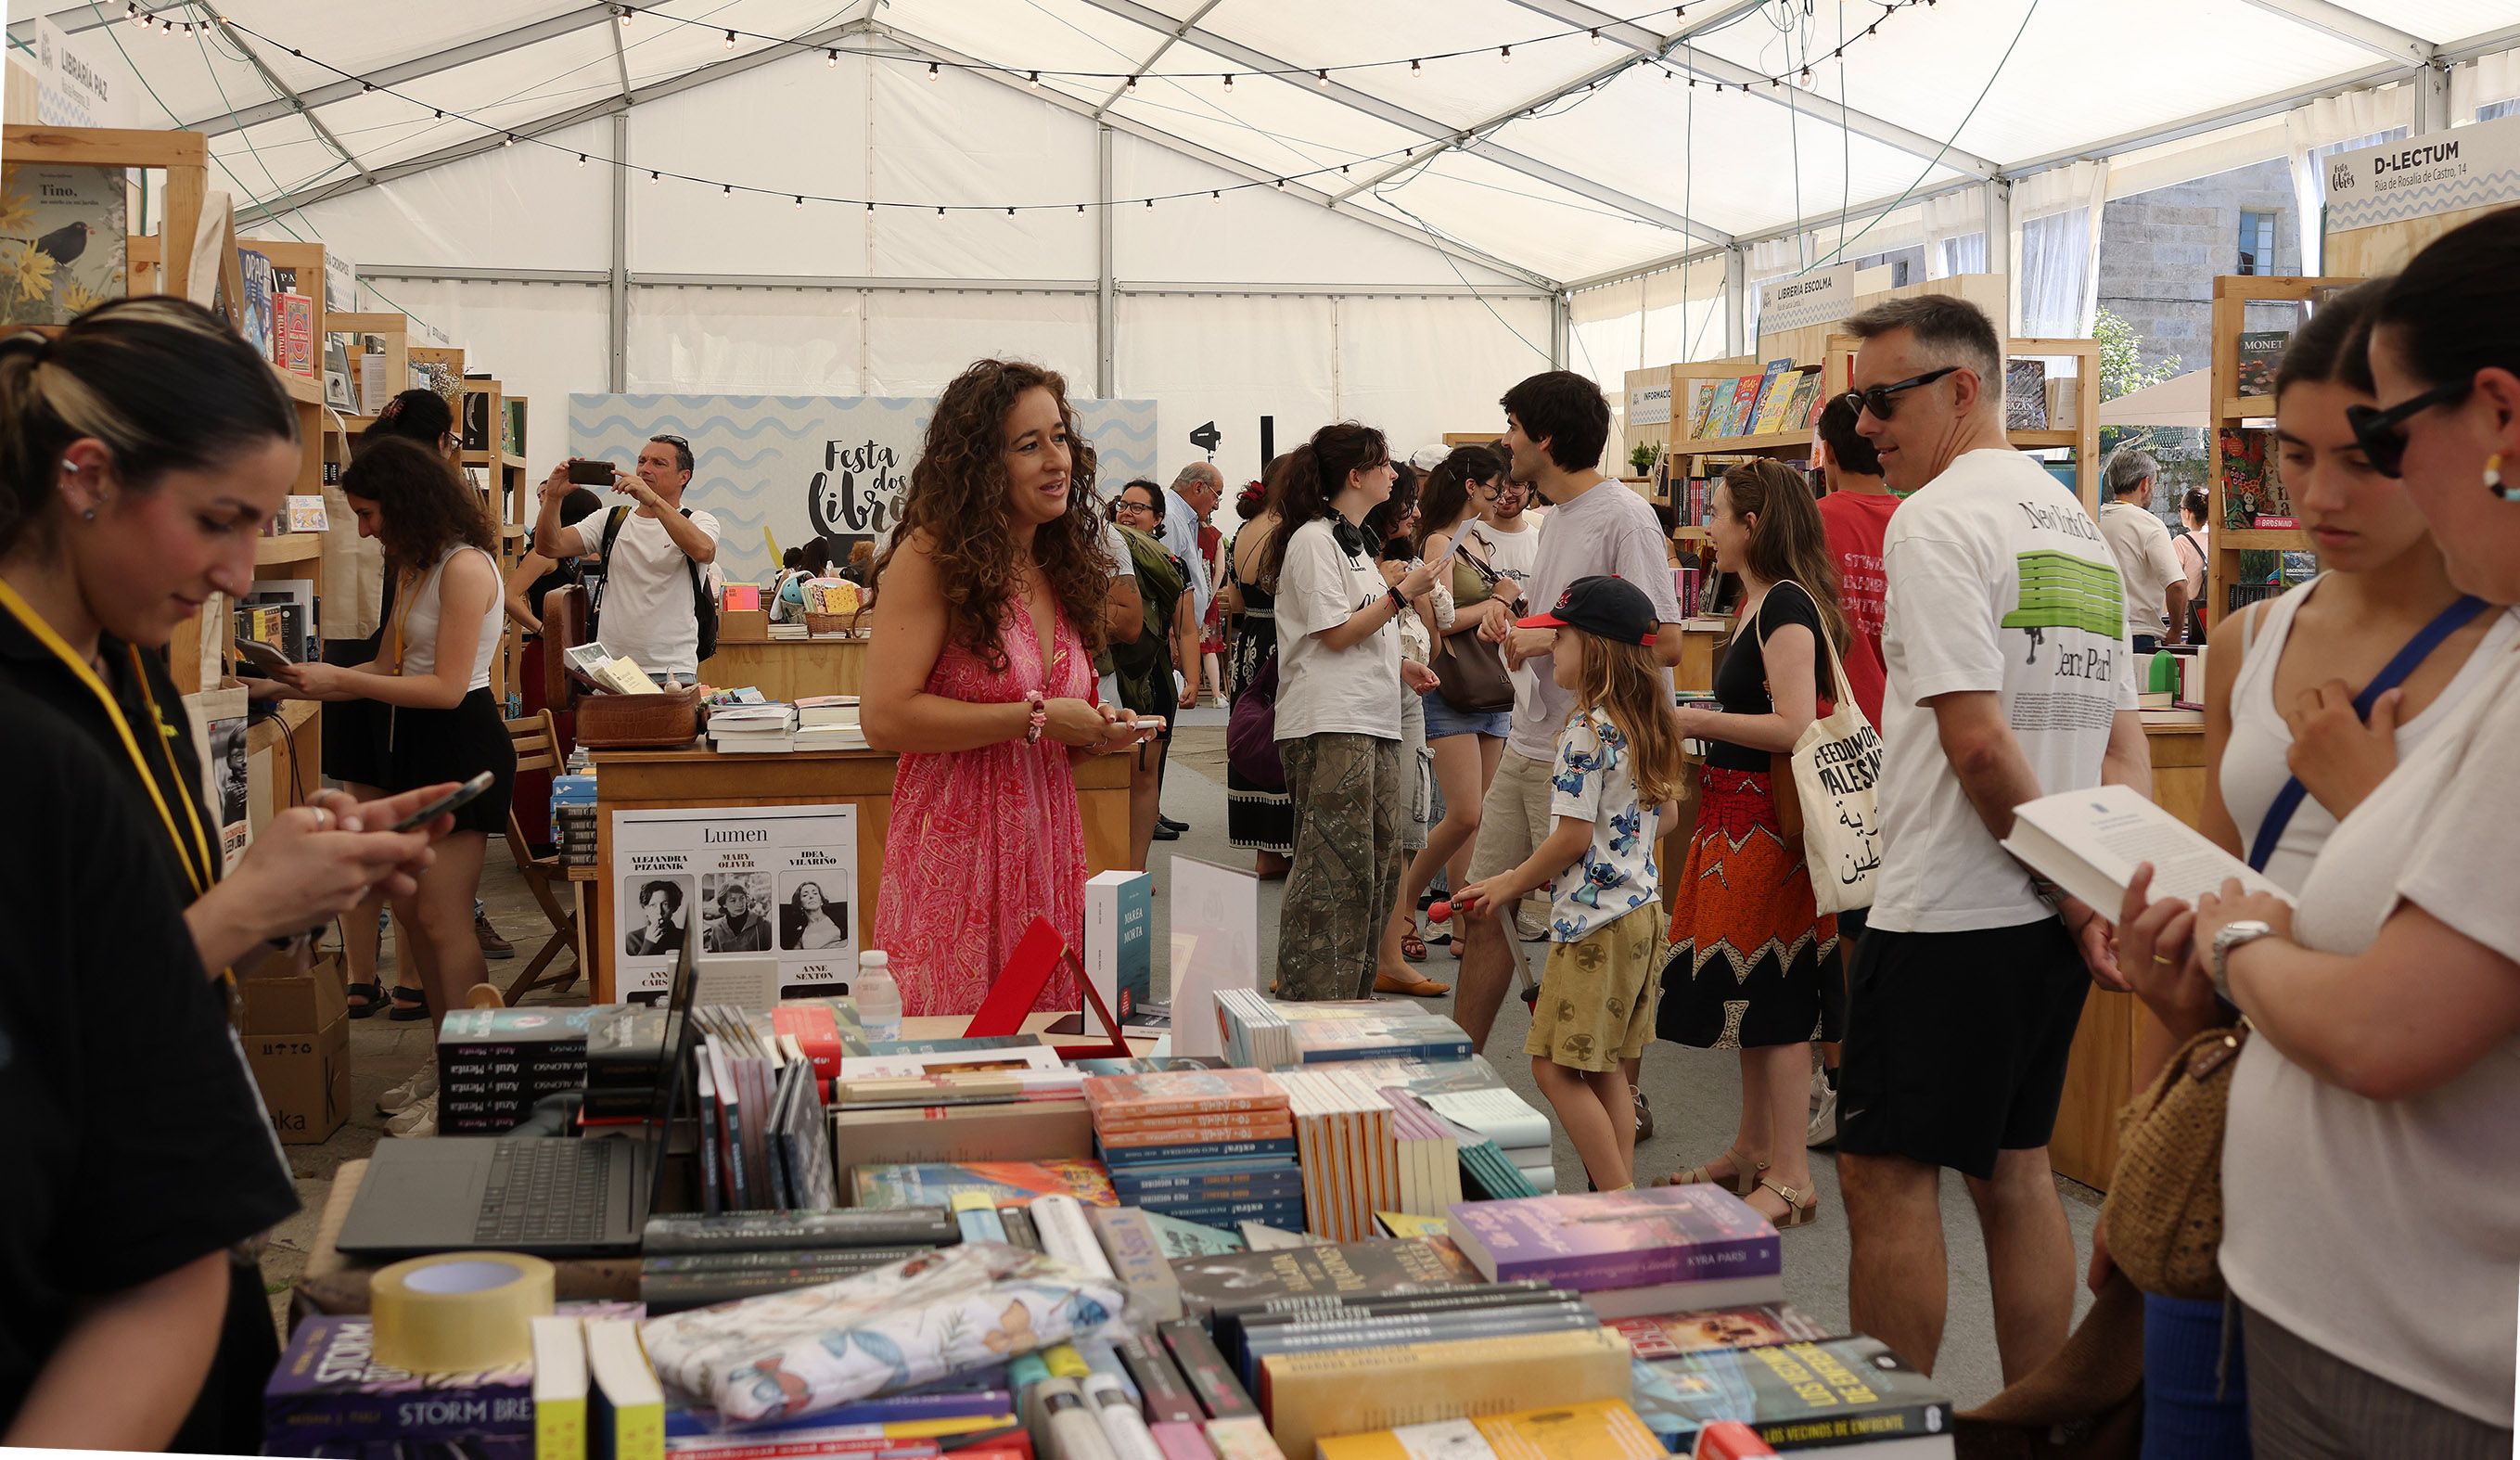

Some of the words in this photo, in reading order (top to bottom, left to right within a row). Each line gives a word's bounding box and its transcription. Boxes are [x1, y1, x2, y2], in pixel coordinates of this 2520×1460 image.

[95, 74, 108, 102] PAZ
[2374, 141, 2459, 174] D-LECTUM
[2374, 179, 2387, 193] Rúa
[2388, 177, 2397, 190] de
[2398, 173, 2422, 188] Rosalía
[2423, 171, 2432, 183] de
[2433, 165, 2457, 182] Castro,
[2458, 162, 2467, 176] 14
[280, 273, 297, 282] PA
[1777, 282, 1804, 301] LIBRERÍA
[1804, 276, 1833, 294] ESCOLMA
[2244, 339, 2285, 350] MONET
[1644, 389, 1671, 402] INFORMACIÓ
[825, 440, 900, 473] Festa
[873, 466, 907, 494] dos
[2018, 502, 2055, 531] New
[704, 827, 768, 843] Lumen
[630, 853, 688, 864] ALEJANDRA
[788, 855, 837, 866] VILARIÑO
[800, 851, 824, 859] IDEA
[634, 863, 684, 871] PIZARNIK
[718, 860, 755, 868] OLIVER
[801, 965, 828, 973] ANNE
[648, 971, 669, 980] ANN
[796, 972, 834, 980] SEXTON
[642, 979, 668, 987] CARS
[451, 1064, 485, 1075] Menta
[495, 1063, 519, 1074] Azul
[451, 1082, 485, 1093] Menta
[495, 1082, 519, 1092] Azul
[1686, 1254, 1716, 1267] KYRA
[1718, 1249, 1748, 1263] PARSI
[315, 1324, 373, 1383] STORM
[398, 1399, 487, 1426] STORM
[493, 1396, 536, 1420] BRE
[1763, 1428, 1785, 1443] LOS
[1786, 1423, 1834, 1439] VECINOS
[1835, 1420, 1848, 1436] DE
[1850, 1414, 1905, 1433] ENFRENTE
